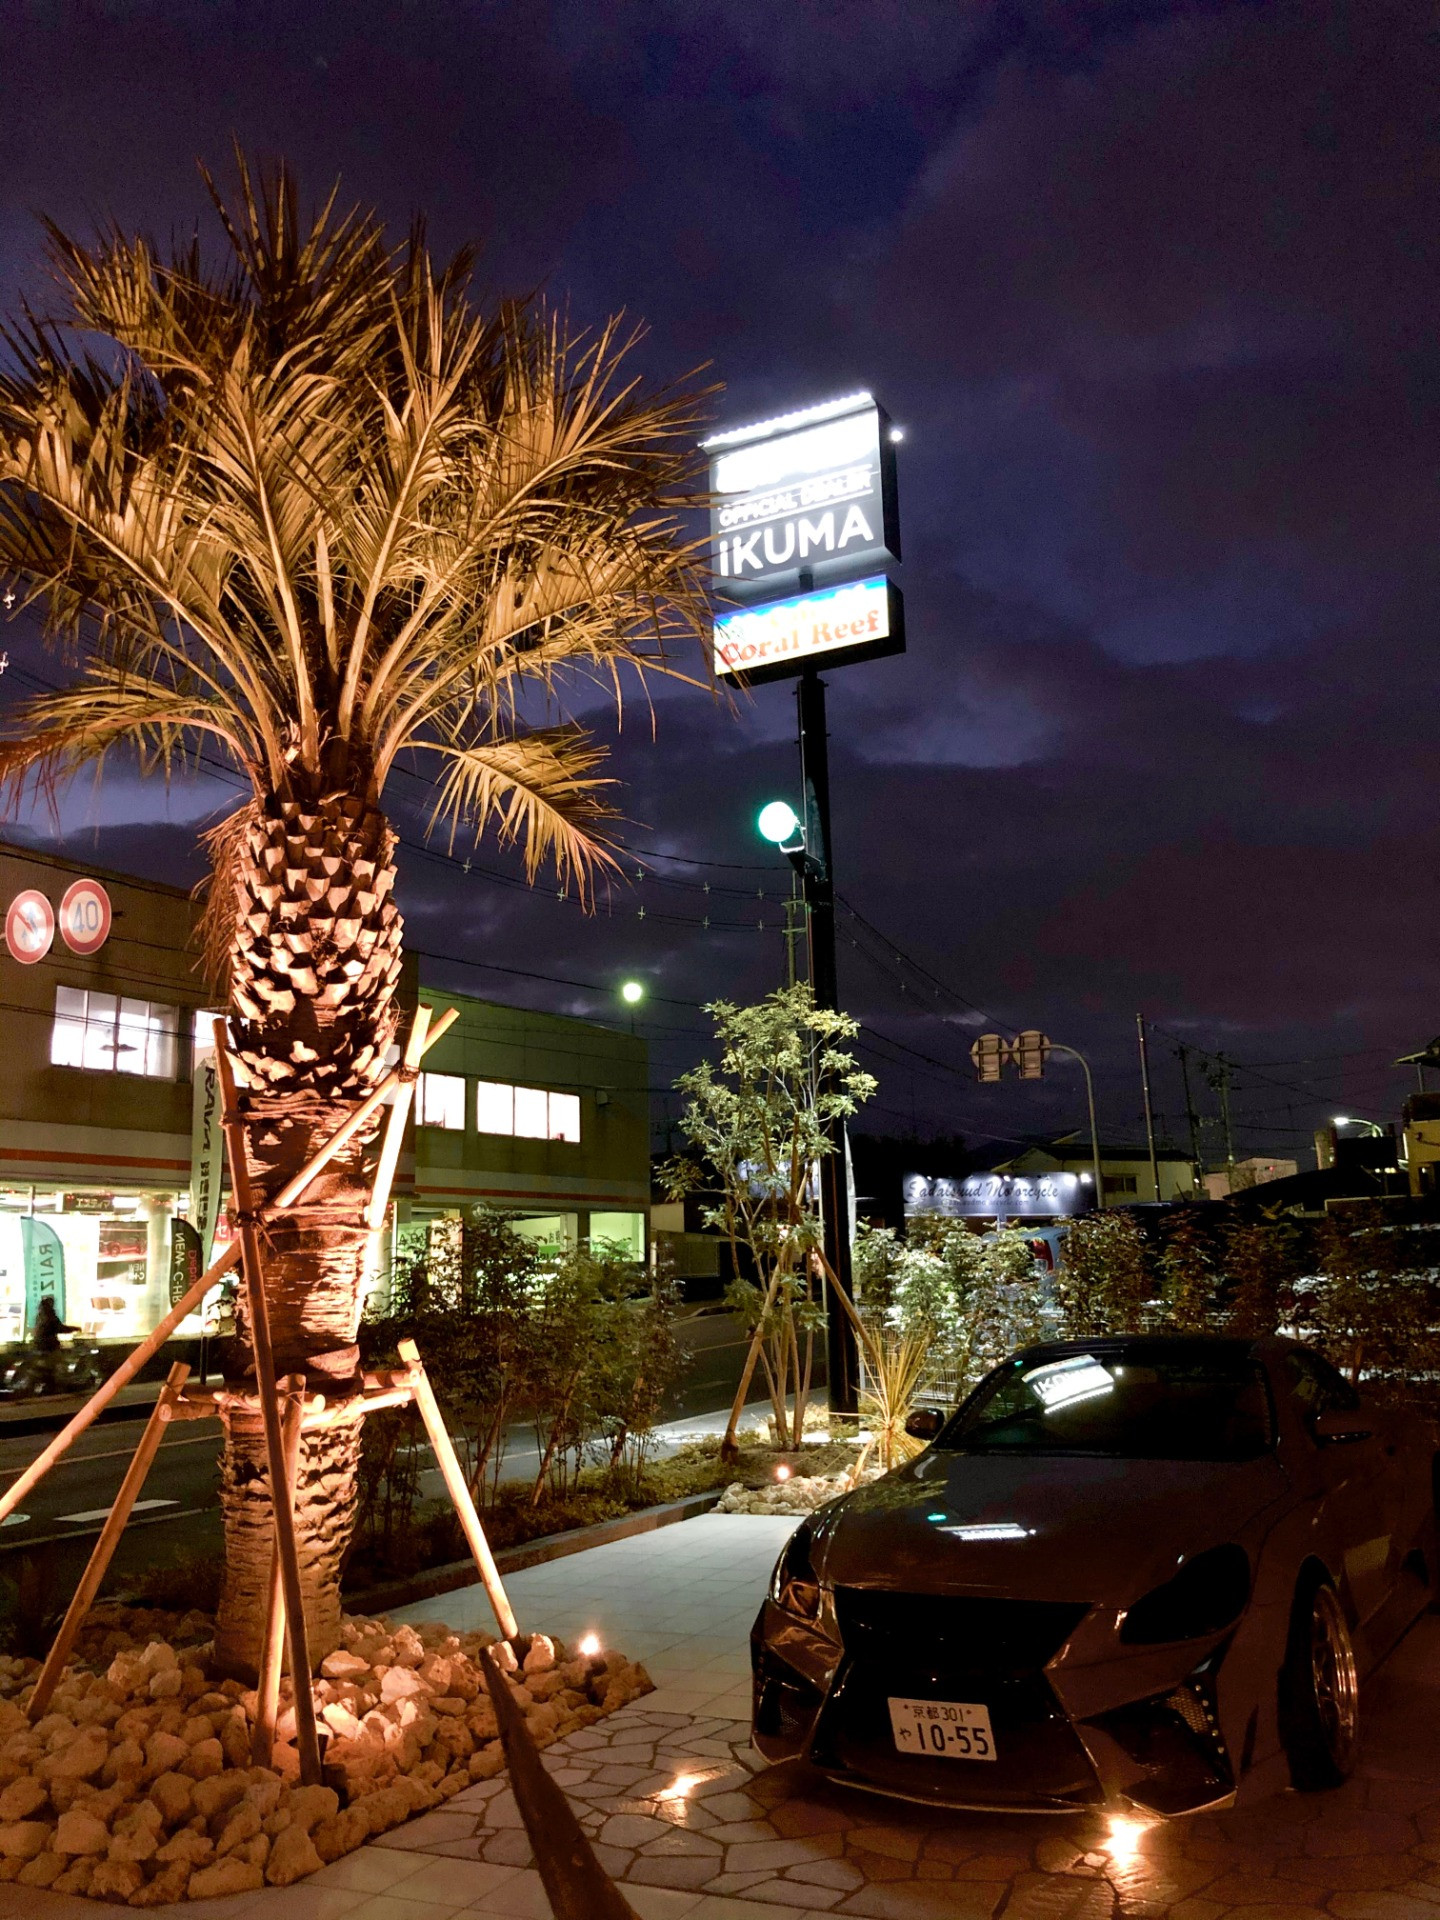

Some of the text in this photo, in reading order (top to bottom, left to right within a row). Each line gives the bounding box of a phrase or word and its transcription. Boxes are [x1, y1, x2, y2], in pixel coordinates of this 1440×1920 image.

[719, 504, 874, 577] IKUMA
[720, 629, 800, 665] Coral
[811, 609, 879, 645] Reef
[72, 900, 99, 933] 40
[985, 1182, 1059, 1202] Motorcycle
[912, 1705, 964, 1723] 京都 301
[899, 1723, 990, 1756] や 10-55
